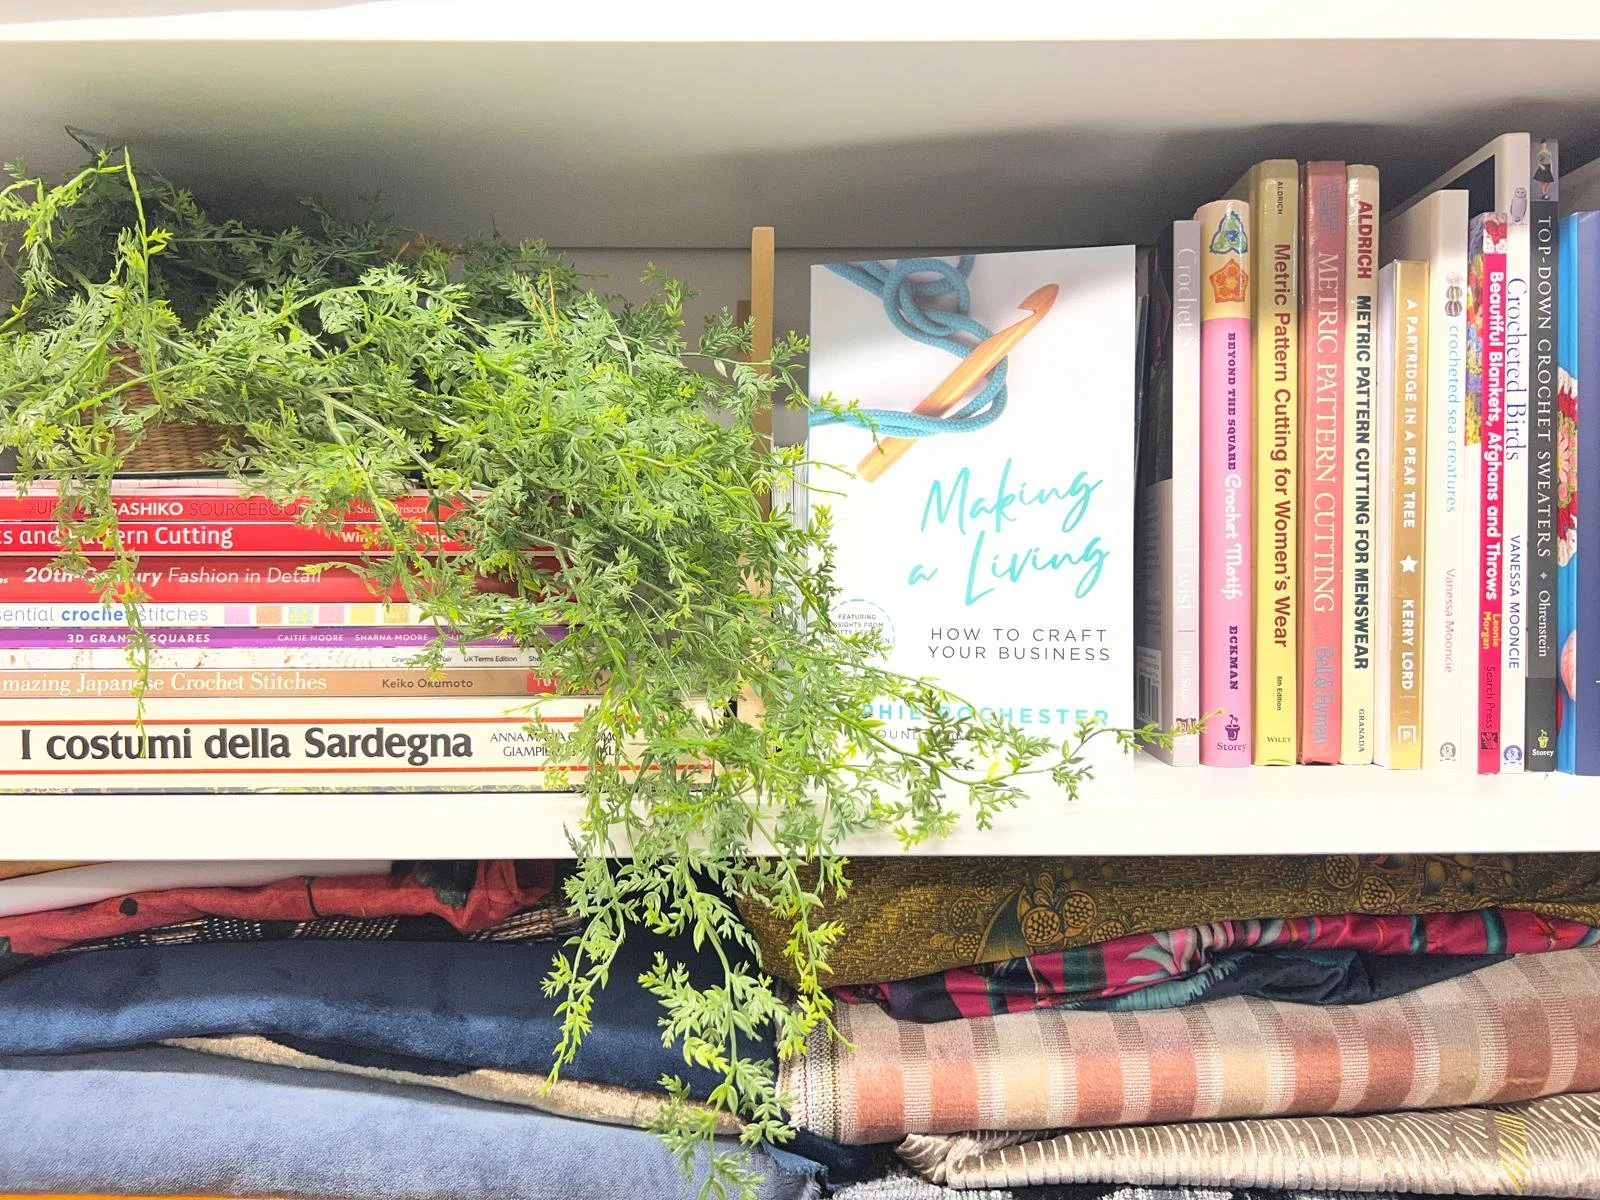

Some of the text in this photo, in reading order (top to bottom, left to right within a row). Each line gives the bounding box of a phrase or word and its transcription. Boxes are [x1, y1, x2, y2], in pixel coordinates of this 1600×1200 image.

[1357, 200, 1373, 279] ALDRICH
[1177, 248, 1197, 331] Crochet
[1317, 252, 1339, 353] METRIC
[1227, 333, 1236, 470] BEYOND THE SQUARE
[1506, 278, 1527, 461] Crocheted Birds
[1269, 244, 1291, 647] Metric Pattern Cutting for Women's Wear
[1315, 363, 1338, 484] PATTERN
[1403, 300, 1418, 528] A PARTRIDGE IN A PEAR TREE
[1447, 325, 1461, 513] crocheted sea creatures
[1484, 271, 1504, 601] Beautiful Blankets, Afghans and Throws
[1537, 215, 1552, 657] TOP-DOWN CROCHET SWEATERS Ohrenstein
[190, 503, 301, 516] SOURCEBOO
[921, 457, 1104, 535] Making
[1224, 474, 1242, 539] Crochet
[1354, 296, 1371, 669] METRIC PATTERN CUTTING FOR MENSWEAR
[155, 526, 234, 549] Cutting
[908, 564, 938, 586] a
[965, 530, 1110, 606] Living
[1313, 492, 1335, 612] CUTTING
[168, 566, 230, 584] Fashion
[245, 567, 260, 583] in
[1508, 534, 1521, 669] VANESSA MOONCIE
[62, 607, 128, 622] croche
[139, 607, 208, 622] stitches
[67, 634, 210, 643] 3D GRAN SQUARES
[310, 633, 344, 642] MOORE
[355, 632, 428, 641] SHARNA MOORE
[931, 627, 1107, 643] HOW TO CRAFT
[1401, 600, 1414, 690] KERRY LORD
[1481, 611, 1491, 650] Morgan
[1492, 613, 1501, 647] Leonie
[171, 671, 244, 691] Crochet
[251, 671, 327, 690] Stitches
[382, 679, 414, 688] Keiko
[928, 646, 1110, 662] YOUR BUSINESS
[1229, 625, 1238, 690] ECKMAN
[1486, 666, 1495, 729] Search Press
[22, 727, 473, 766] I costumi della Sardegna
[490, 733, 524, 742] ANNA
[1217, 741, 1247, 752] Storey
[1532, 748, 1554, 757] Storey
